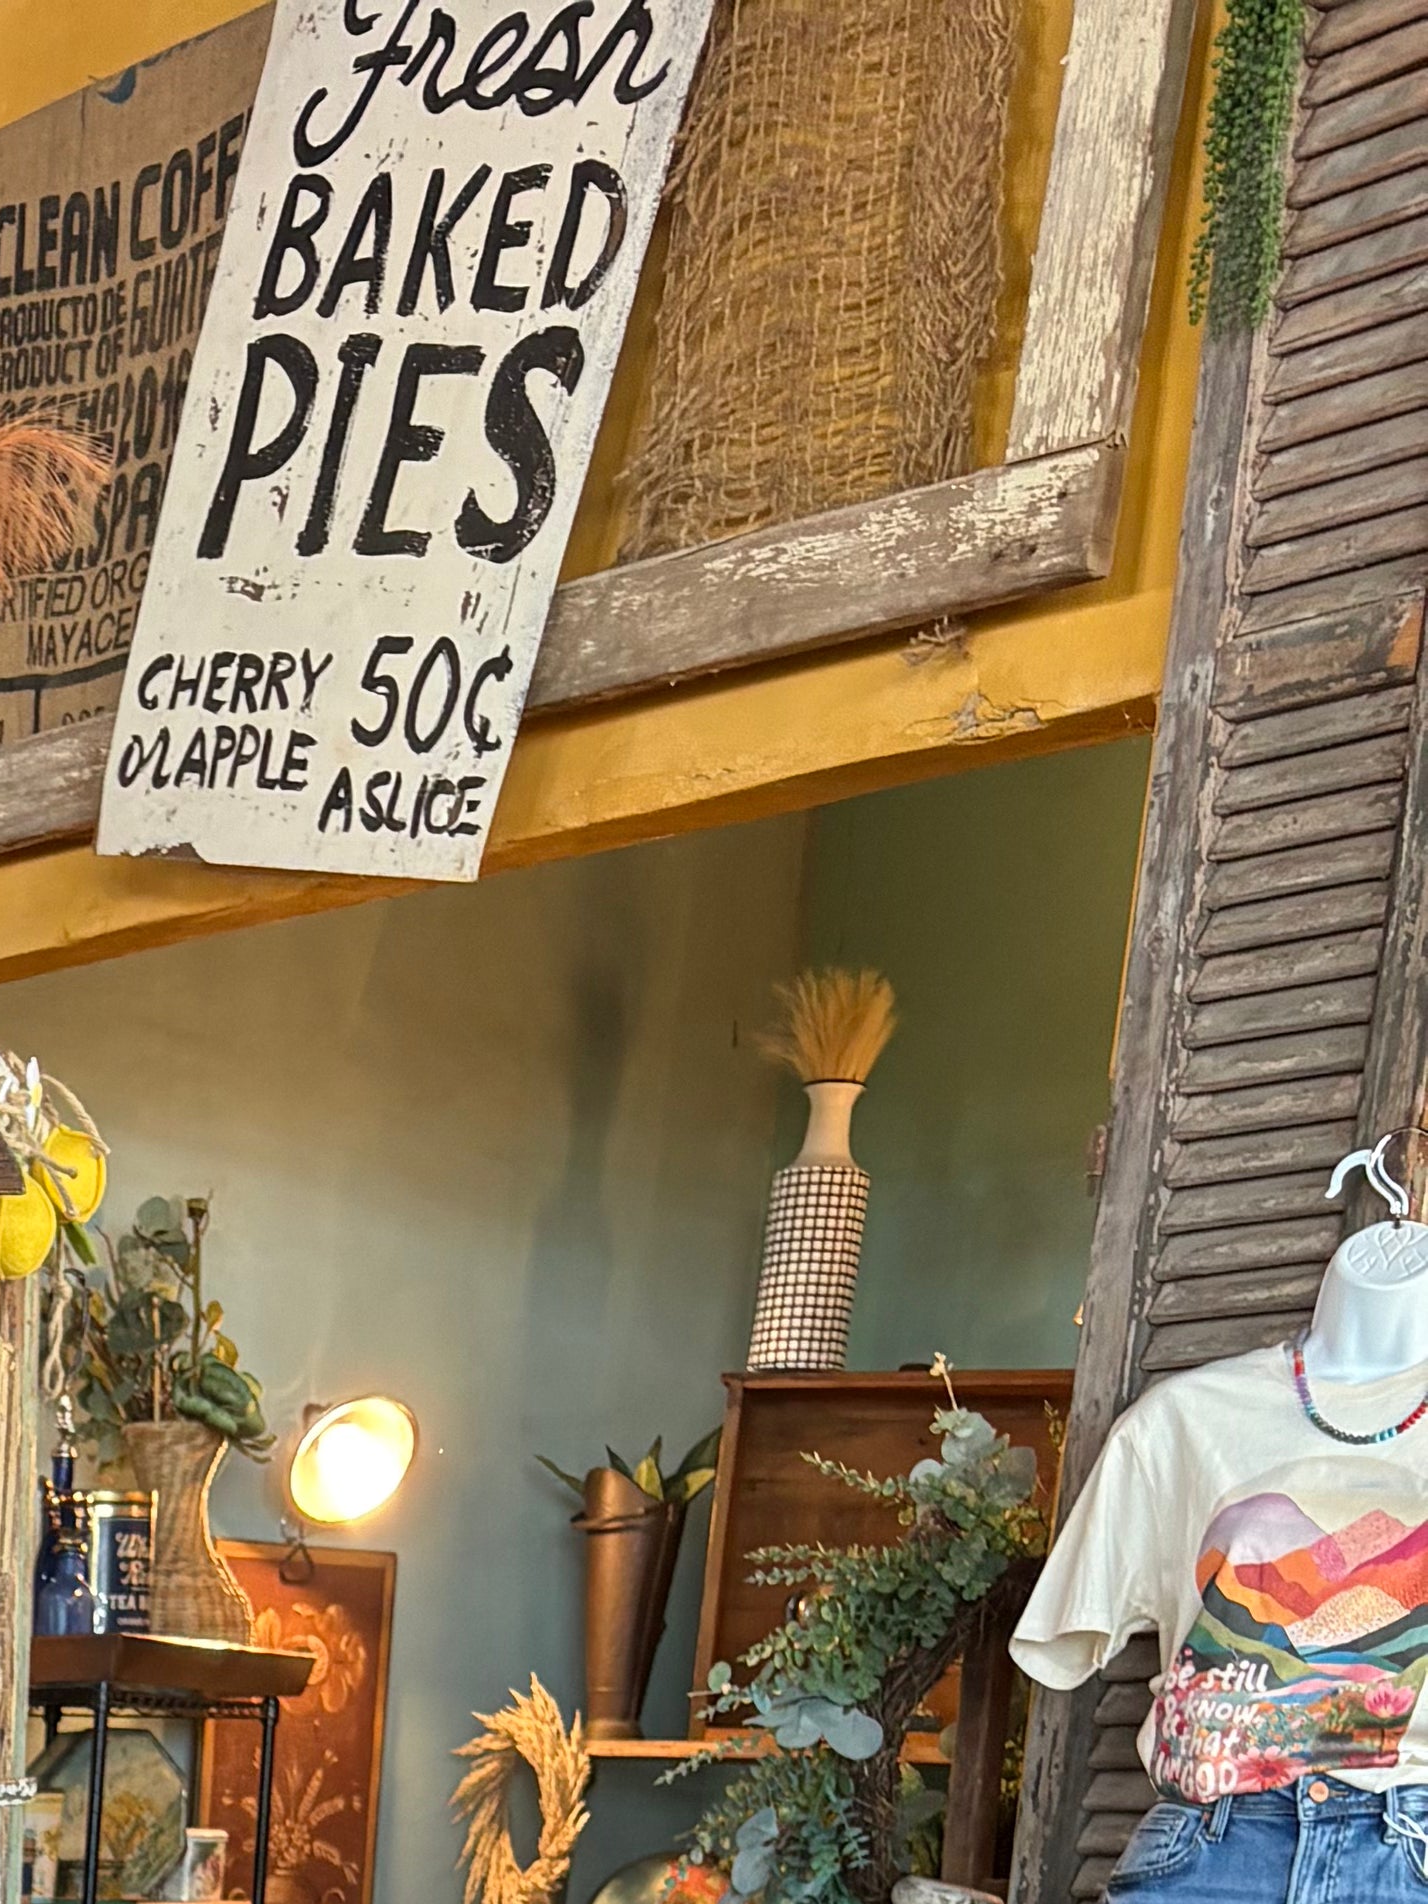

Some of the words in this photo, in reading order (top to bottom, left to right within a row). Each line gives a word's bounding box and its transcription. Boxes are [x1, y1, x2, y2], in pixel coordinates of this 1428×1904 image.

[129, 104, 254, 261] COFF
[252, 159, 628, 320] BAKED
[99, 279, 127, 332] DE
[96, 327, 124, 379] OF
[196, 325, 585, 565] PIES
[25, 602, 143, 669] MAYACE
[137, 647, 334, 715] CHERRY
[173, 724, 319, 791] APPLE
[317, 766, 354, 834] A
[357, 770, 488, 839] SLICE
[1200, 1659, 1269, 1693] still
